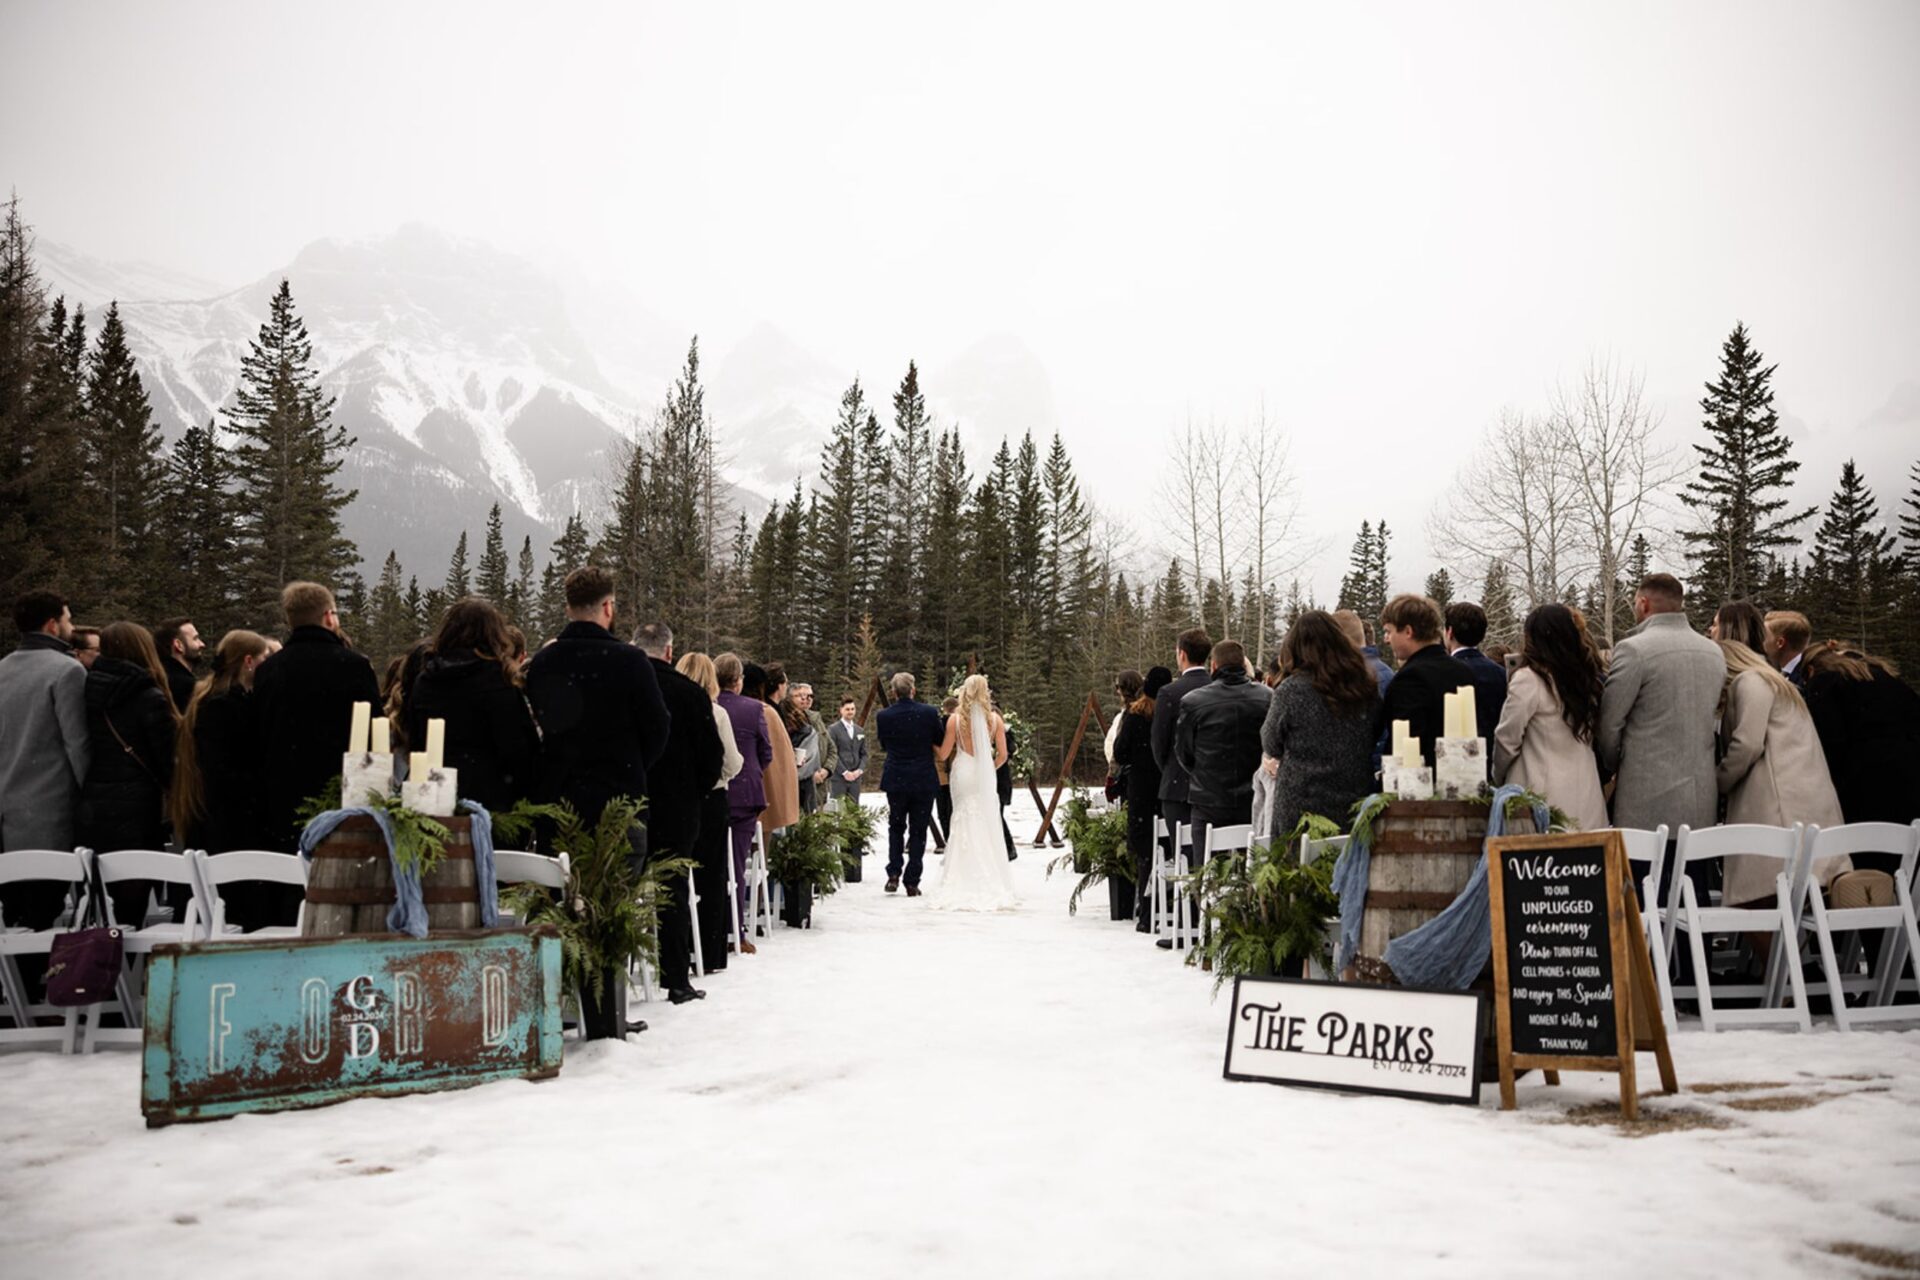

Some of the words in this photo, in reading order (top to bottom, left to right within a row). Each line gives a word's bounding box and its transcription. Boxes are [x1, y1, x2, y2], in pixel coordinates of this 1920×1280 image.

[1508, 855, 1602, 880] Welcome
[1543, 885, 1553, 896] TO
[1554, 885, 1570, 895] OUR
[1521, 900, 1594, 915] UNPLUGGED
[1526, 920, 1591, 940] ceremony
[1519, 940, 1551, 959] Please
[1553, 946, 1571, 957] TURN
[1572, 946, 1584, 957] OFF
[1586, 946, 1598, 957] ALL
[1522, 966, 1537, 977] CELL
[1538, 965, 1564, 977] PHONES
[1572, 965, 1601, 977] CAMERA
[346, 975, 377, 1010] G
[1513, 987, 1527, 999] AND
[1528, 989, 1554, 1006] enjoy
[1556, 988, 1572, 1000] THIS
[1573, 982, 1613, 1006] Special
[208, 964, 509, 1075] FORD
[1528, 1013, 1558, 1025] MOMENT
[1561, 1012, 1584, 1028] with
[1586, 1015, 1599, 1028] us
[346, 1022, 380, 1059] D
[1241, 1001, 1308, 1052] THE
[1317, 1011, 1434, 1064] PARKS
[1539, 1037, 1568, 1050] THANK
[1569, 1038, 1589, 1050] YOU!
[1399, 1061, 1413, 1073] 02
[1418, 1063, 1432, 1074] 24
[1437, 1065, 1467, 1077] 2024
